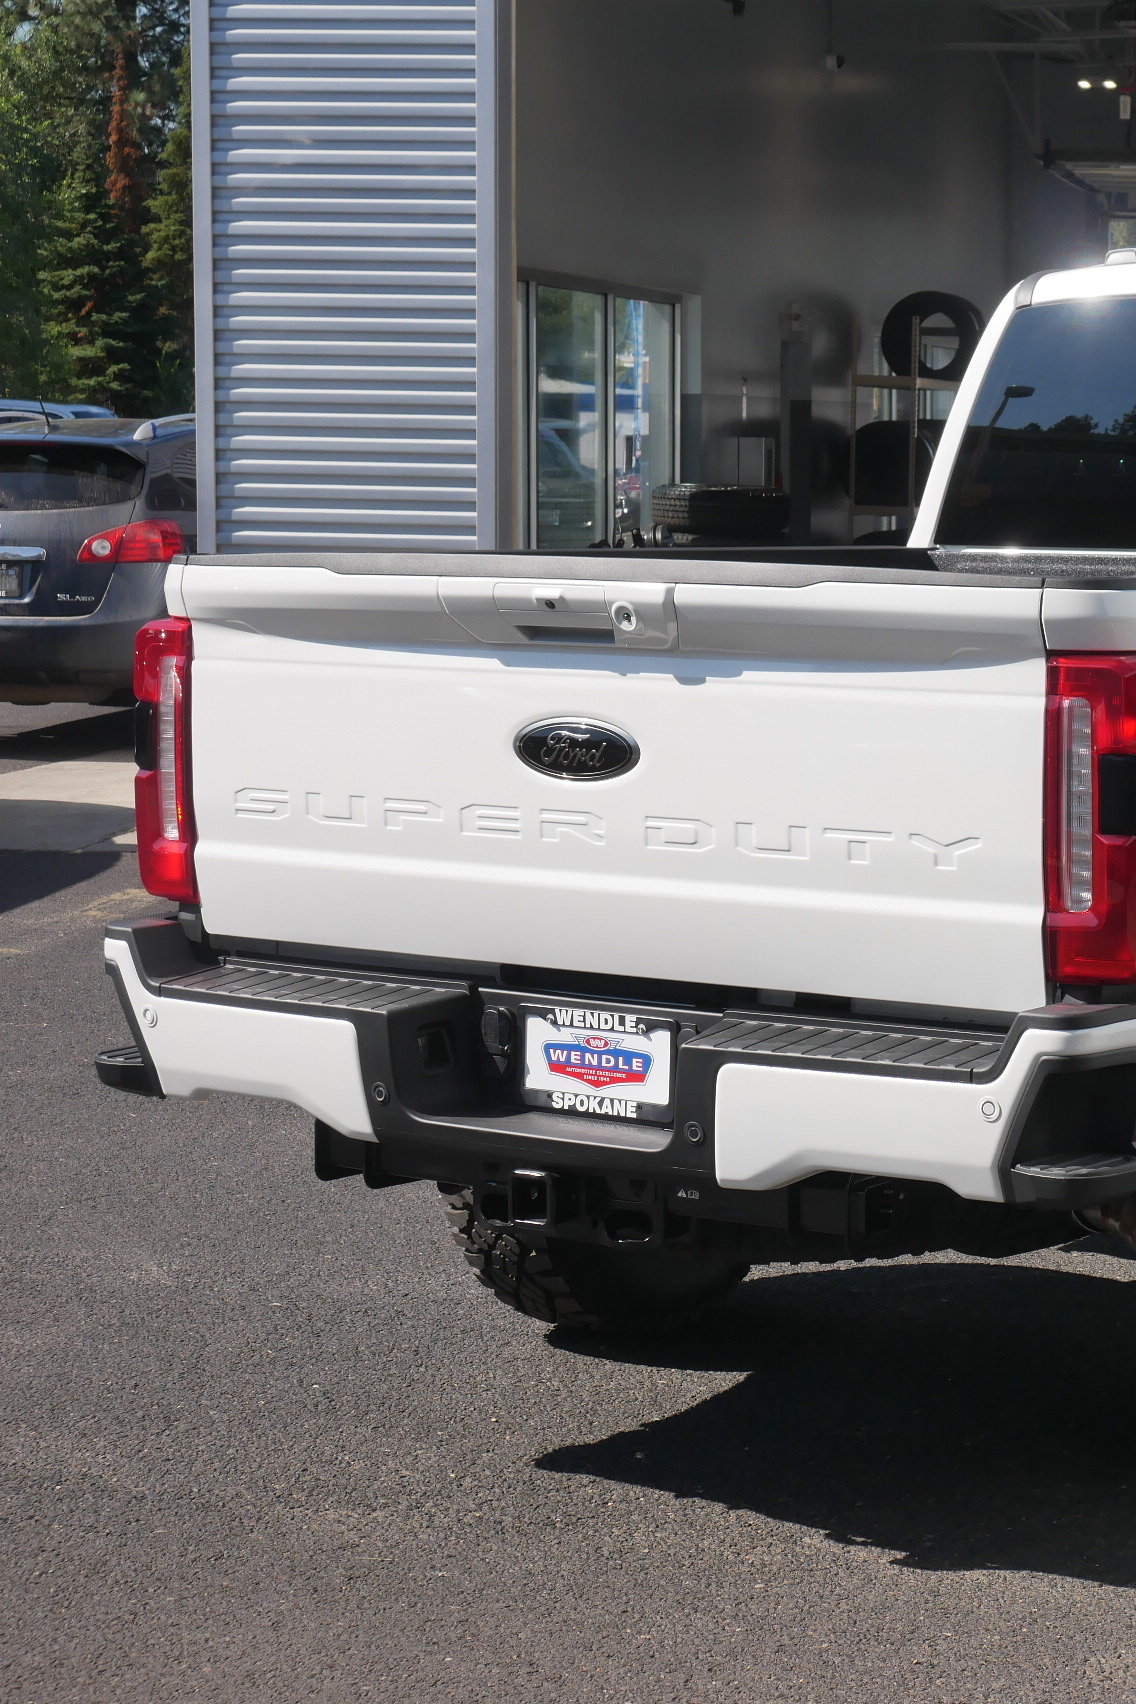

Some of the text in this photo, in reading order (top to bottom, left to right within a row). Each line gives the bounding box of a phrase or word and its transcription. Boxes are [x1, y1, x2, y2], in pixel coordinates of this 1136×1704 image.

[57, 593, 73, 601] SL
[541, 731, 607, 767] Ford
[235, 787, 983, 870] SUPER DUTY
[554, 1008, 637, 1033] WENDLE
[549, 1048, 645, 1071] WENDLE
[552, 1091, 638, 1118] SPOKANE
